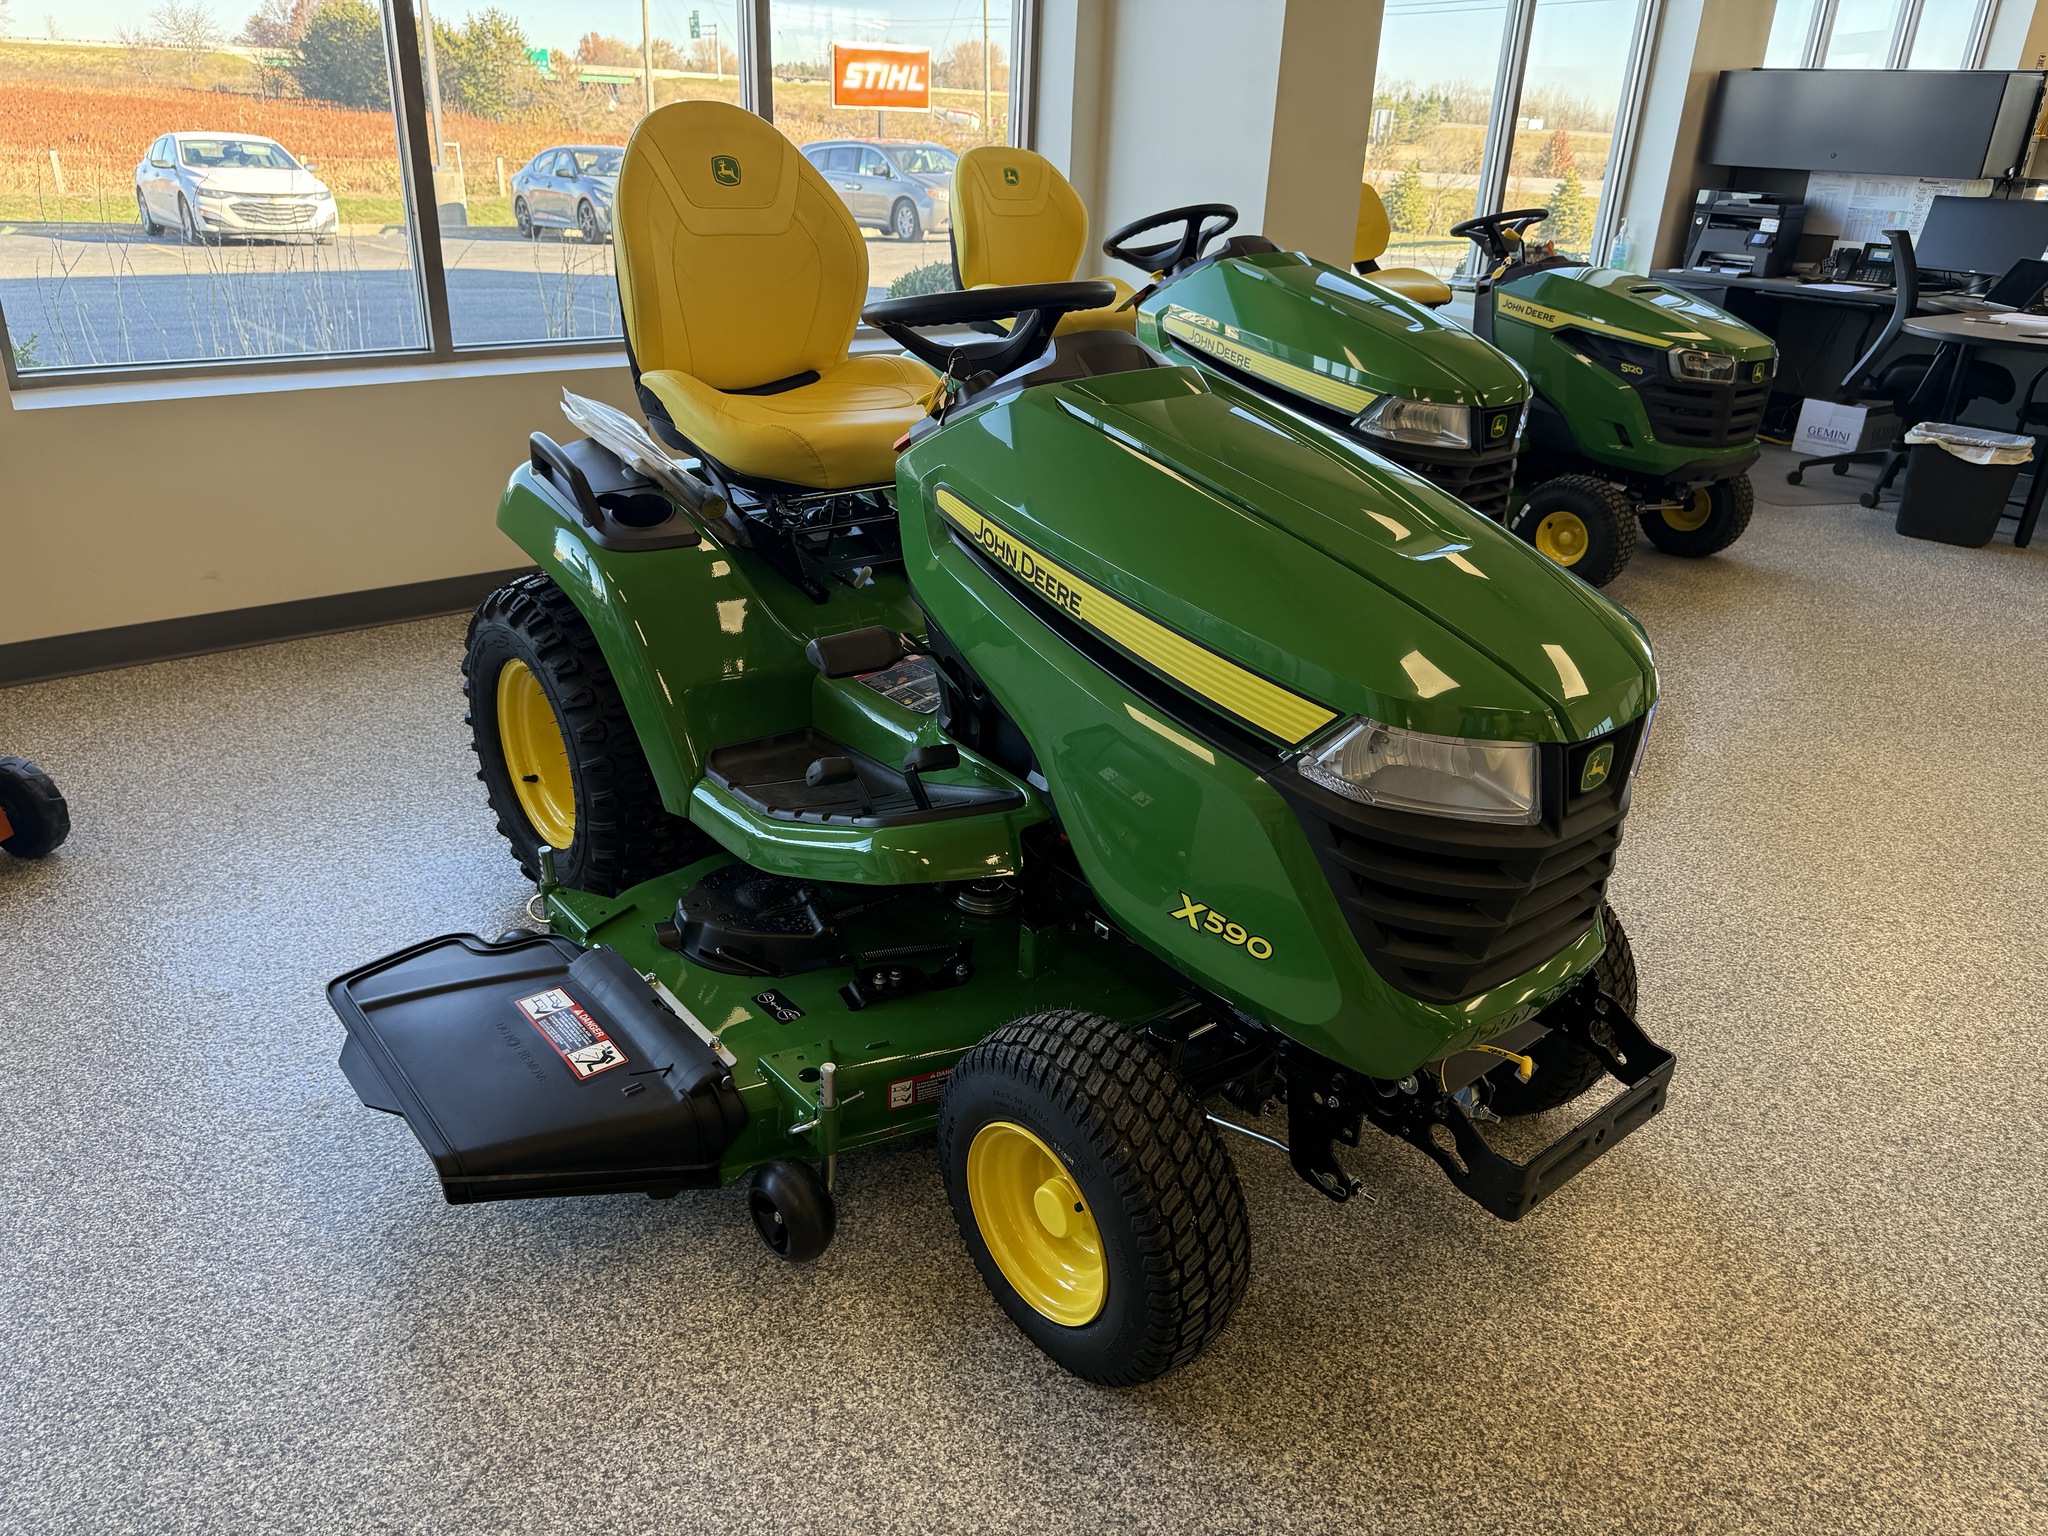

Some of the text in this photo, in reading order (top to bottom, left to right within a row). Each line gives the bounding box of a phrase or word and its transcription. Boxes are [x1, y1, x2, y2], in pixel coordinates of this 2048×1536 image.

[842, 62, 925, 92] STIHL
[1502, 299, 1556, 323] JOHN DEERE
[1189, 329, 1252, 369] JOHN DEERE
[1621, 363, 1643, 375] S120
[1807, 425, 1851, 441] GEMINI
[974, 518, 1083, 617] JOHN DEERE
[1167, 889, 1274, 961] X590
[579, 1013, 605, 1038] DANGER
